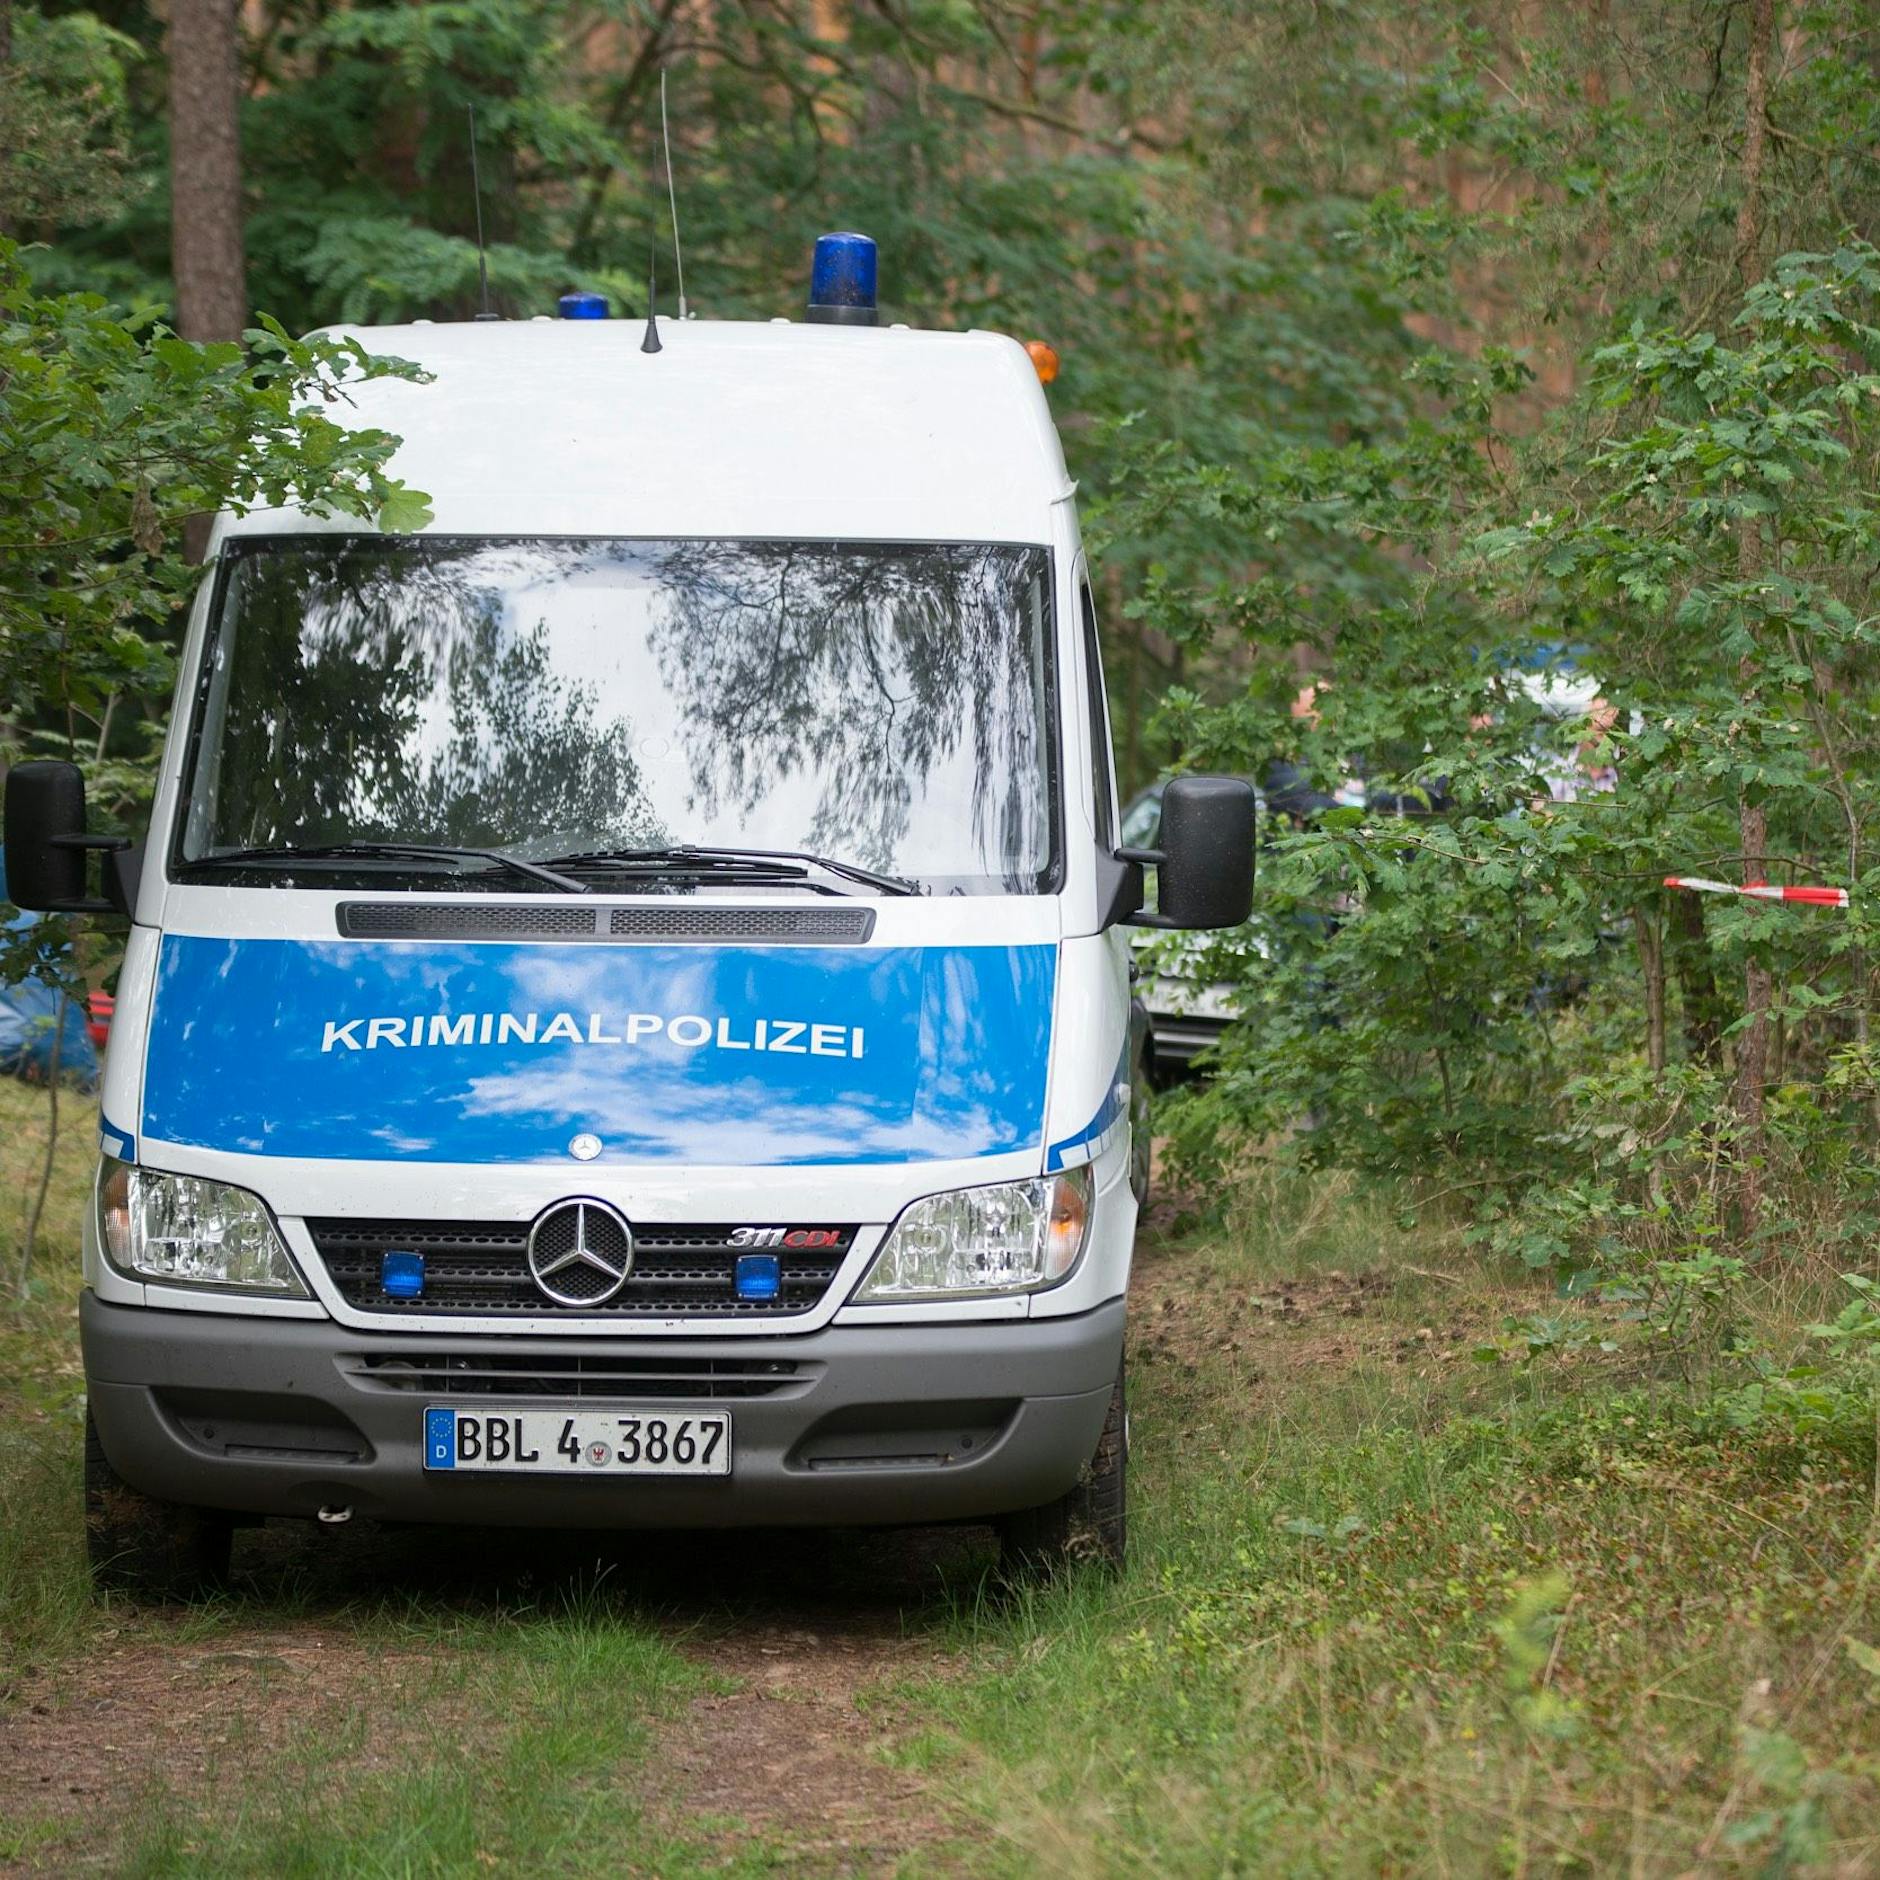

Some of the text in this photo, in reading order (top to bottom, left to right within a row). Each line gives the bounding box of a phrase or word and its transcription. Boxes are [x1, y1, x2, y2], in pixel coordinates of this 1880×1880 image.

[321, 1013, 864, 1059] KRIMINALPOLIZEI
[435, 1417, 724, 1465] D BBL 4 3867
